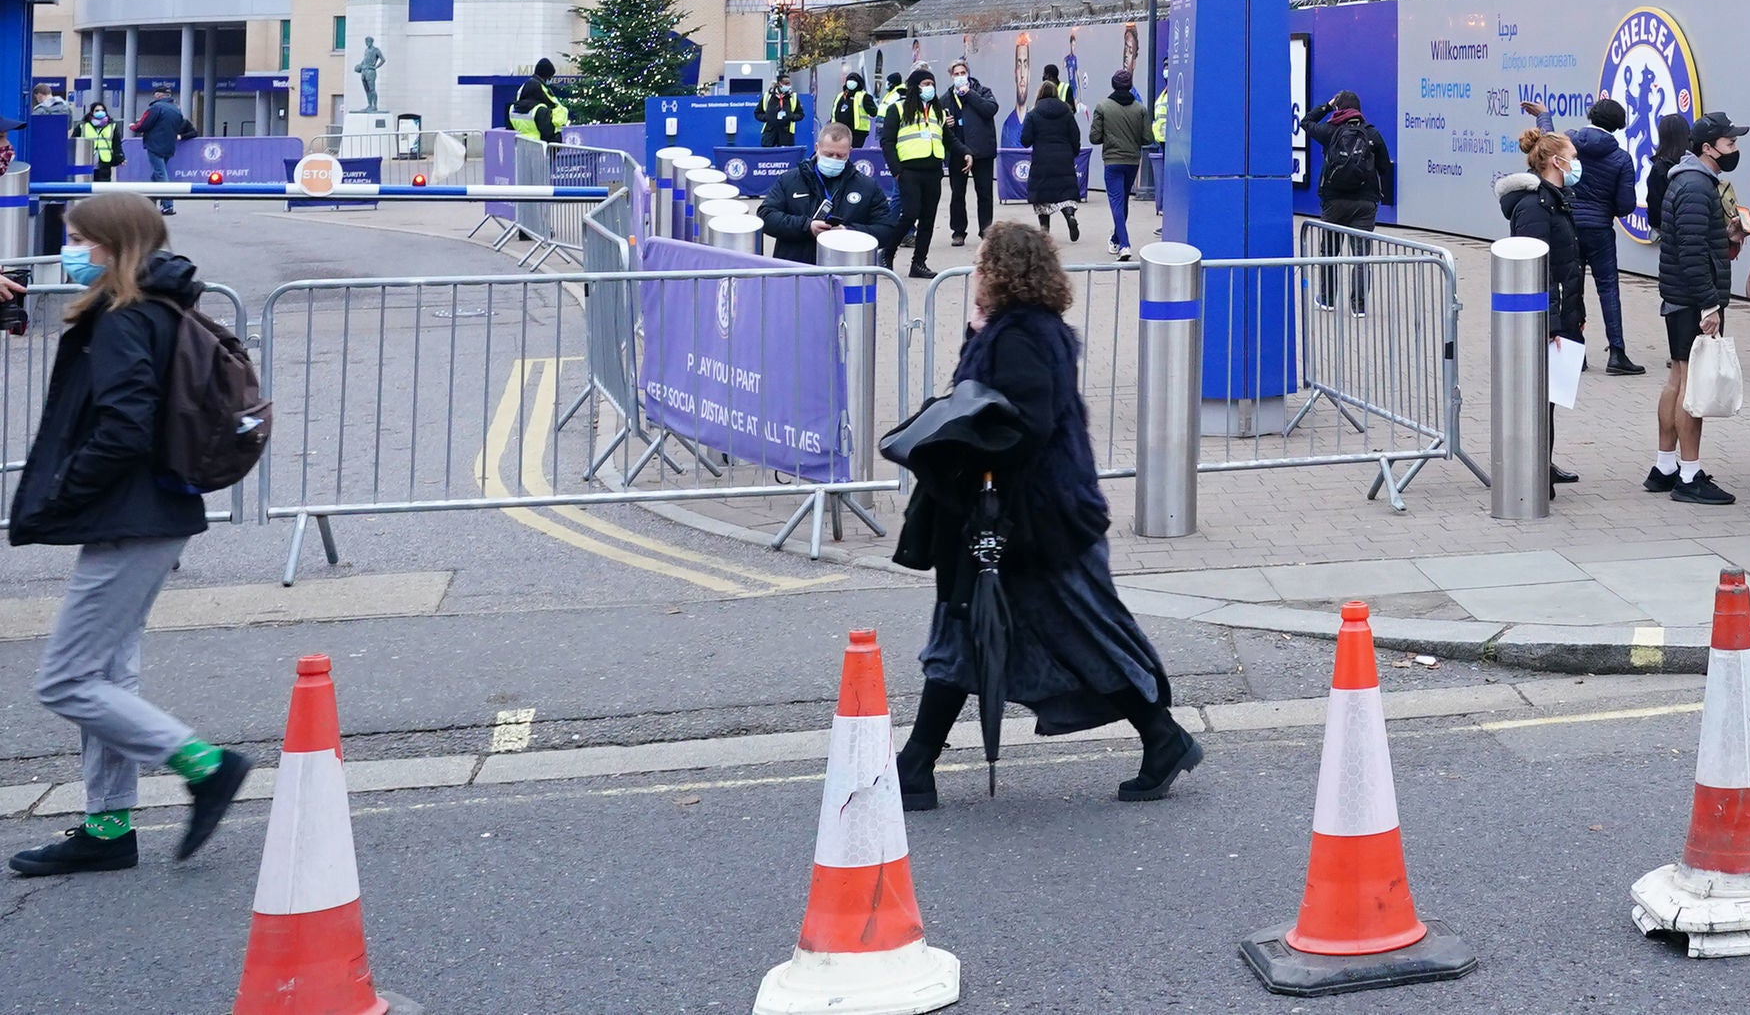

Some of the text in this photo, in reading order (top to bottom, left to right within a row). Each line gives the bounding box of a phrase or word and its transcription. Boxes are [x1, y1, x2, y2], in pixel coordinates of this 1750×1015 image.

[1430, 40, 1488, 60] Willkommen
[1611, 16, 1676, 68] CHELSEA
[1502, 53, 1577, 71] Добро пожаловать
[1421, 78, 1471, 99] Bienvenue
[1486, 87, 1510, 116] 欢迎
[1405, 113, 1445, 130] Bem-vindo
[175, 169, 197, 177] PLAY
[226, 169, 249, 177] PART
[757, 161, 789, 169] SECURITY
[1427, 160, 1462, 176] Benvenuto
[687, 353, 712, 377] PAY
[736, 368, 761, 393] PART
[668, 388, 695, 414] SOCIA
[746, 414, 758, 437] AT
